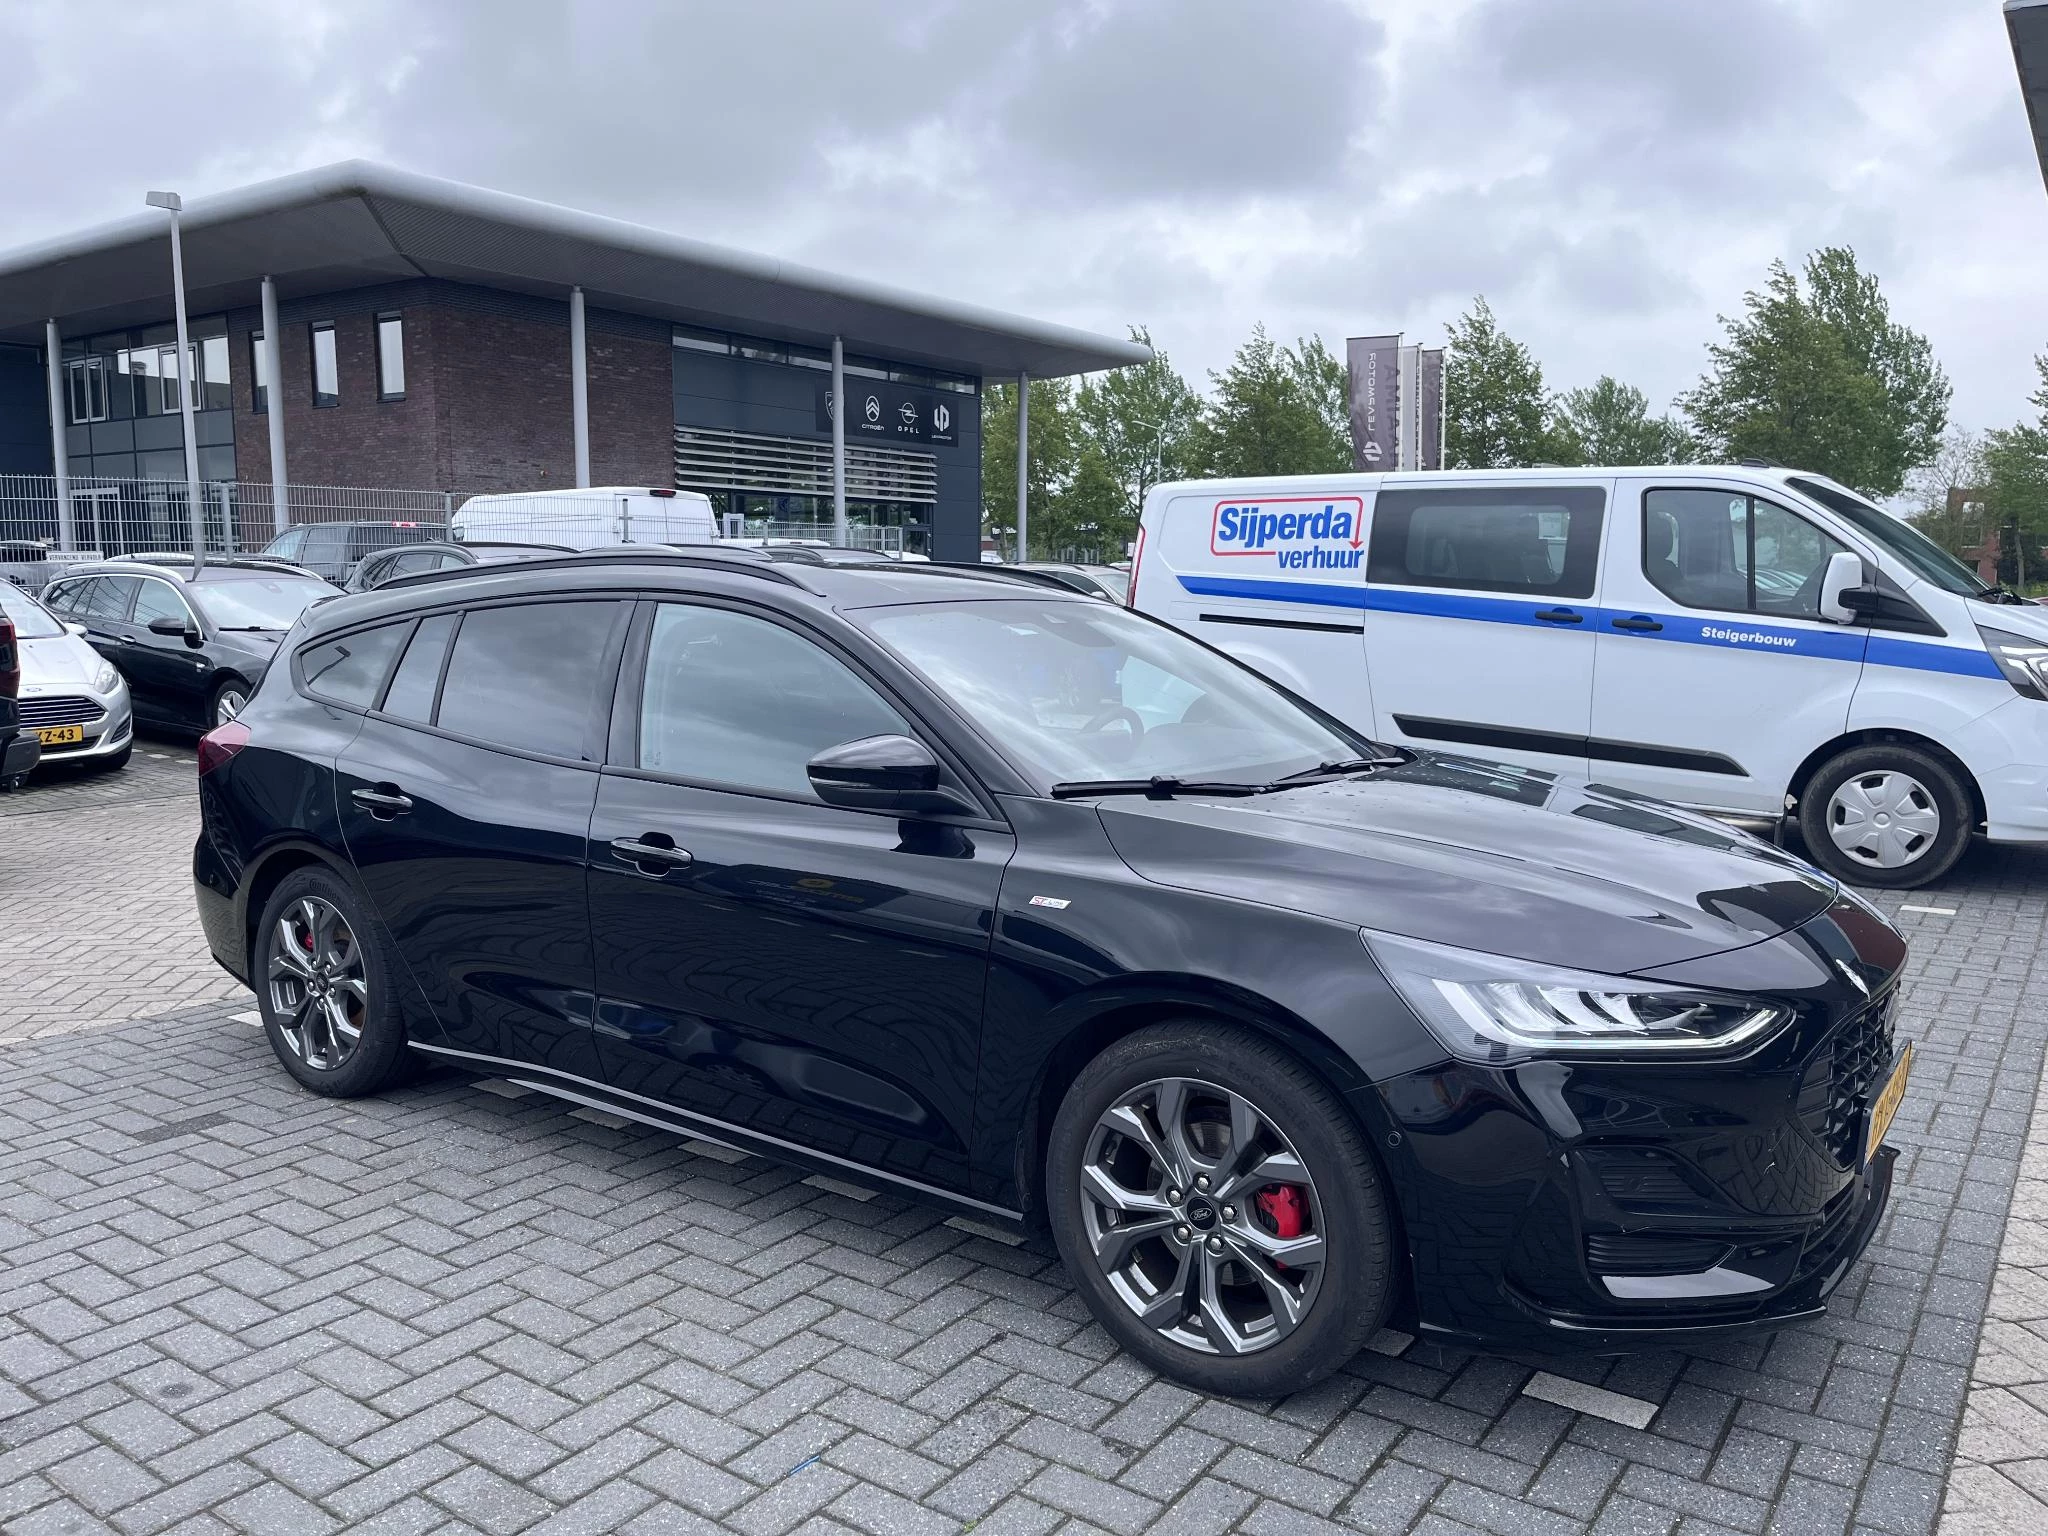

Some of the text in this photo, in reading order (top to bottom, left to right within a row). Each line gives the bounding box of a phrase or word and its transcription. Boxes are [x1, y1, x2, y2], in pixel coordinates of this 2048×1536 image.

[897, 425, 920, 434] OPEL
[1218, 505, 1353, 548] Sijperda
[1278, 545, 1365, 569] verhuur
[1701, 626, 1797, 647] Steigerbouw
